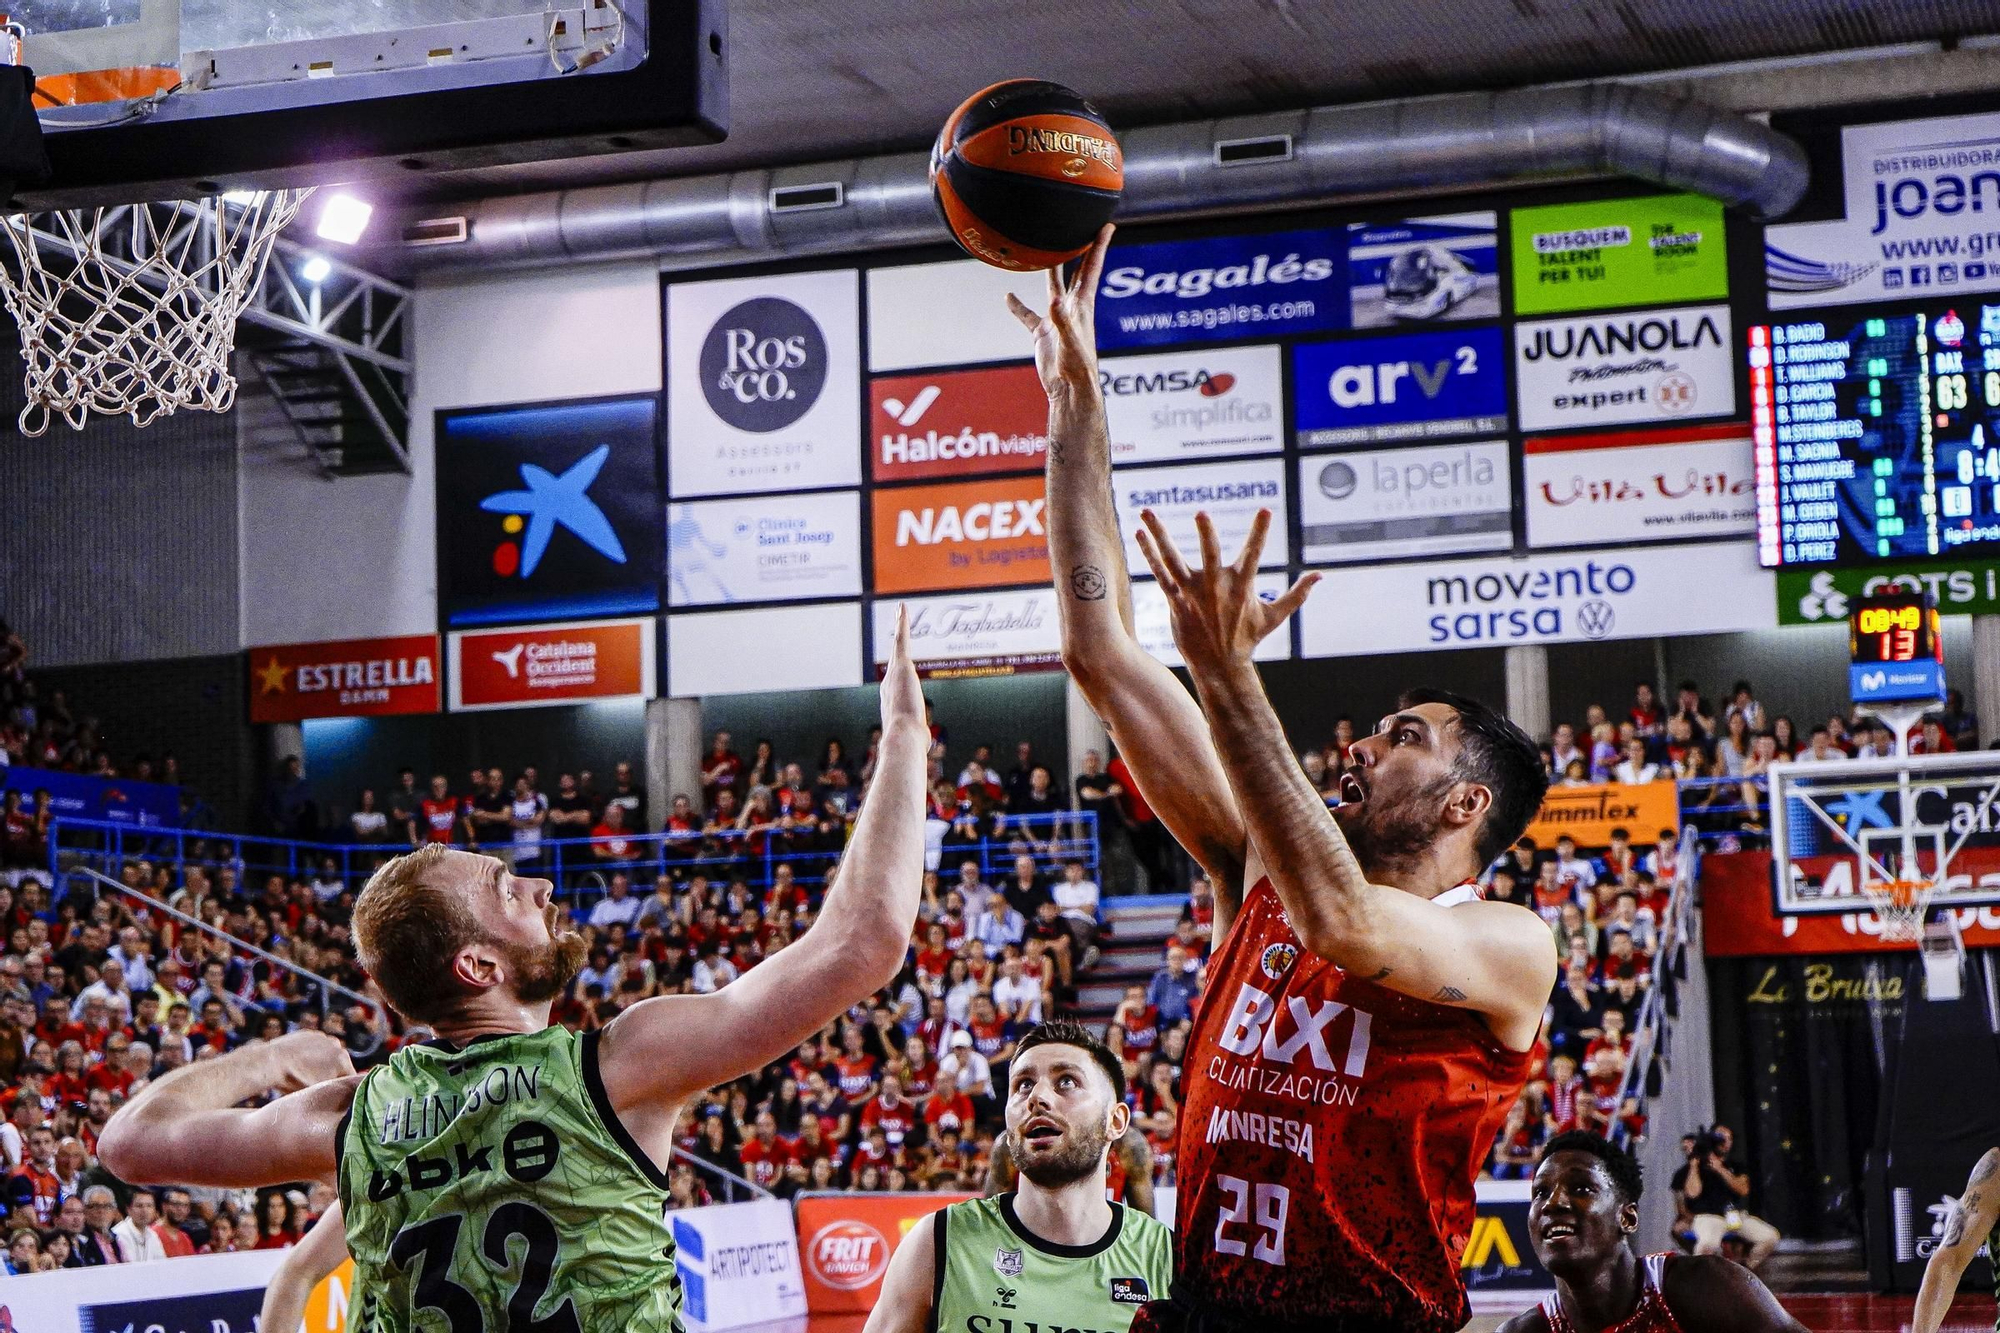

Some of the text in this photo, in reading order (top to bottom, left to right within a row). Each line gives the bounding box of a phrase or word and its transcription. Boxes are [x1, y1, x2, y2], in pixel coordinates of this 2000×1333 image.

[1881, 231, 2000, 260] www.gr
[1101, 253, 1333, 299] Sagalés
[1119, 300, 1315, 334] www.sagales.com
[1524, 315, 1722, 361] JUANOLA
[1553, 386, 1647, 410] expert
[1936, 374, 1967, 410] 63
[1151, 399, 1273, 432] simplifica
[881, 426, 1000, 465] Halcón
[1129, 480, 1279, 507] santasusana
[895, 498, 1045, 547] NACEX
[1428, 563, 1636, 605] movento
[1430, 607, 1562, 642] sarsa
[525, 641, 597, 660] Catalana
[1880, 630, 1916, 661] 13
[297, 656, 433, 692] ESTRELLA
[1215, 1173, 1290, 1266] 29
[818, 1236, 878, 1264] FRIT
[391, 1202, 585, 1333] 32
[1113, 1284, 1131, 1295] liga
[1114, 1292, 1148, 1302] endesa
